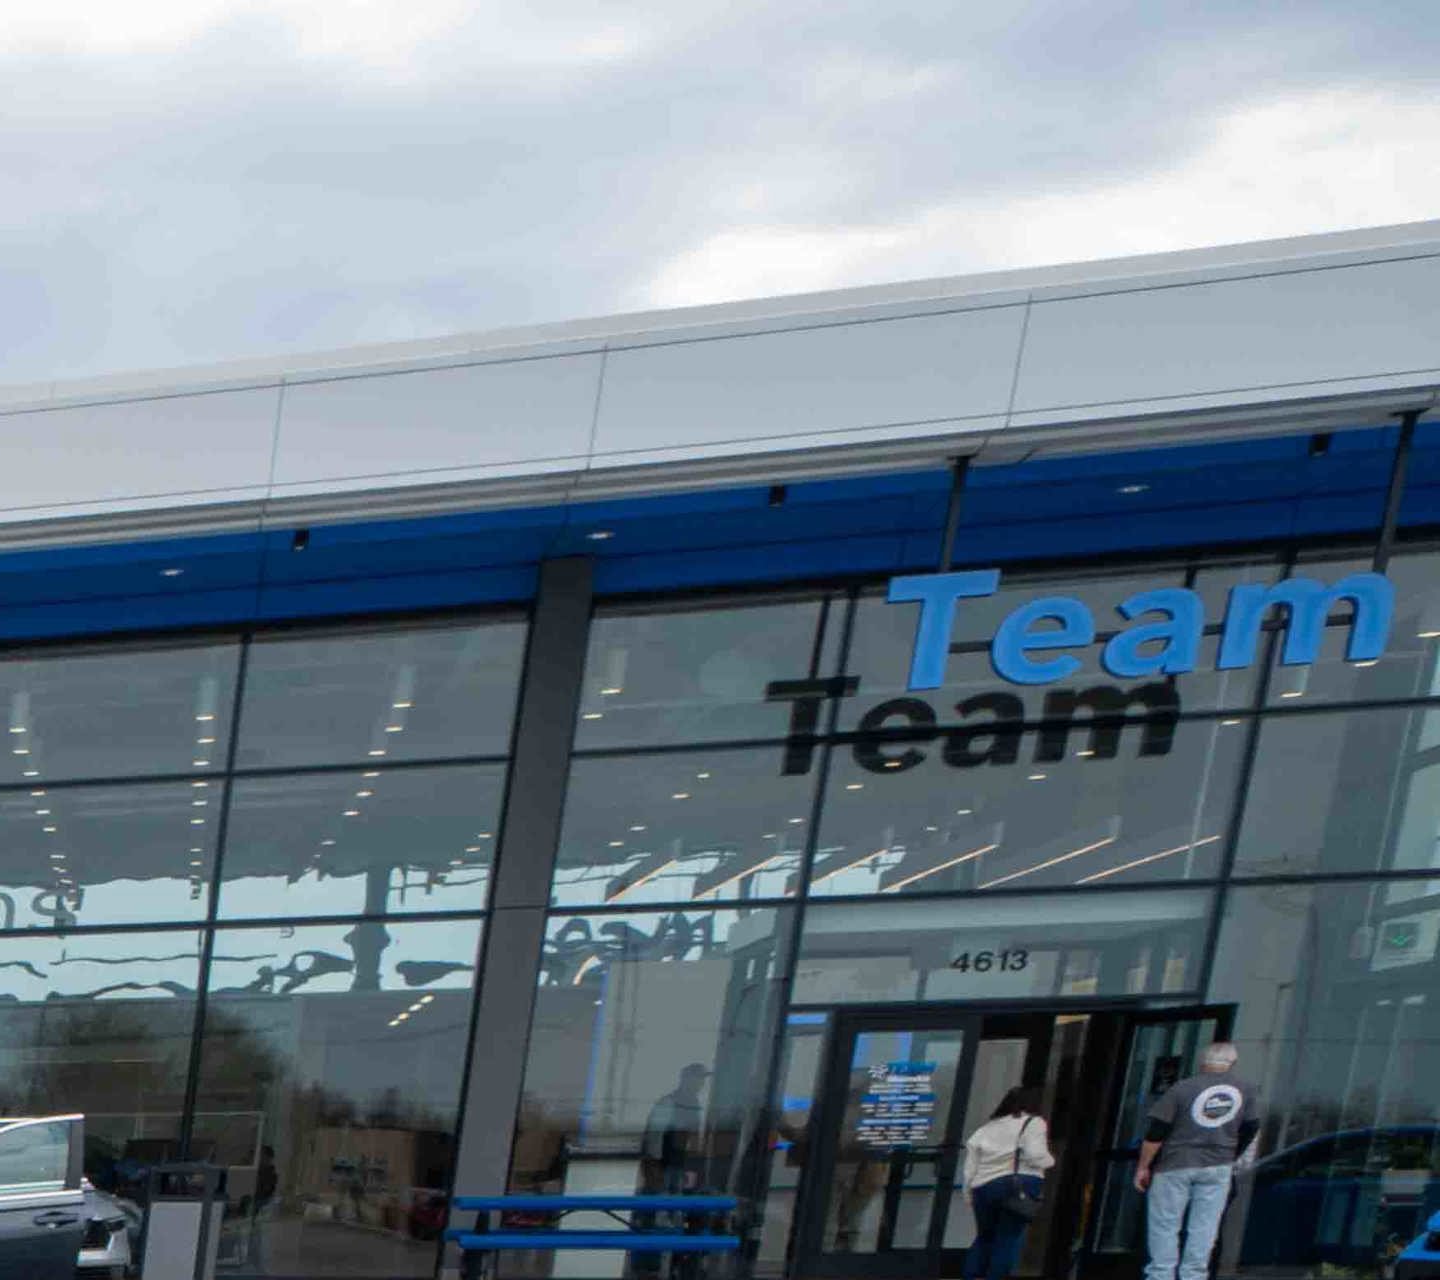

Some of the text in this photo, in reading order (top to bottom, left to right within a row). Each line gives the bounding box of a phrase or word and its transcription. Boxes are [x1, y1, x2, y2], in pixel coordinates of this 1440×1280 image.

[886, 568, 1397, 692] Team
[766, 675, 1181, 777] Team
[949, 949, 1029, 973] 4613
